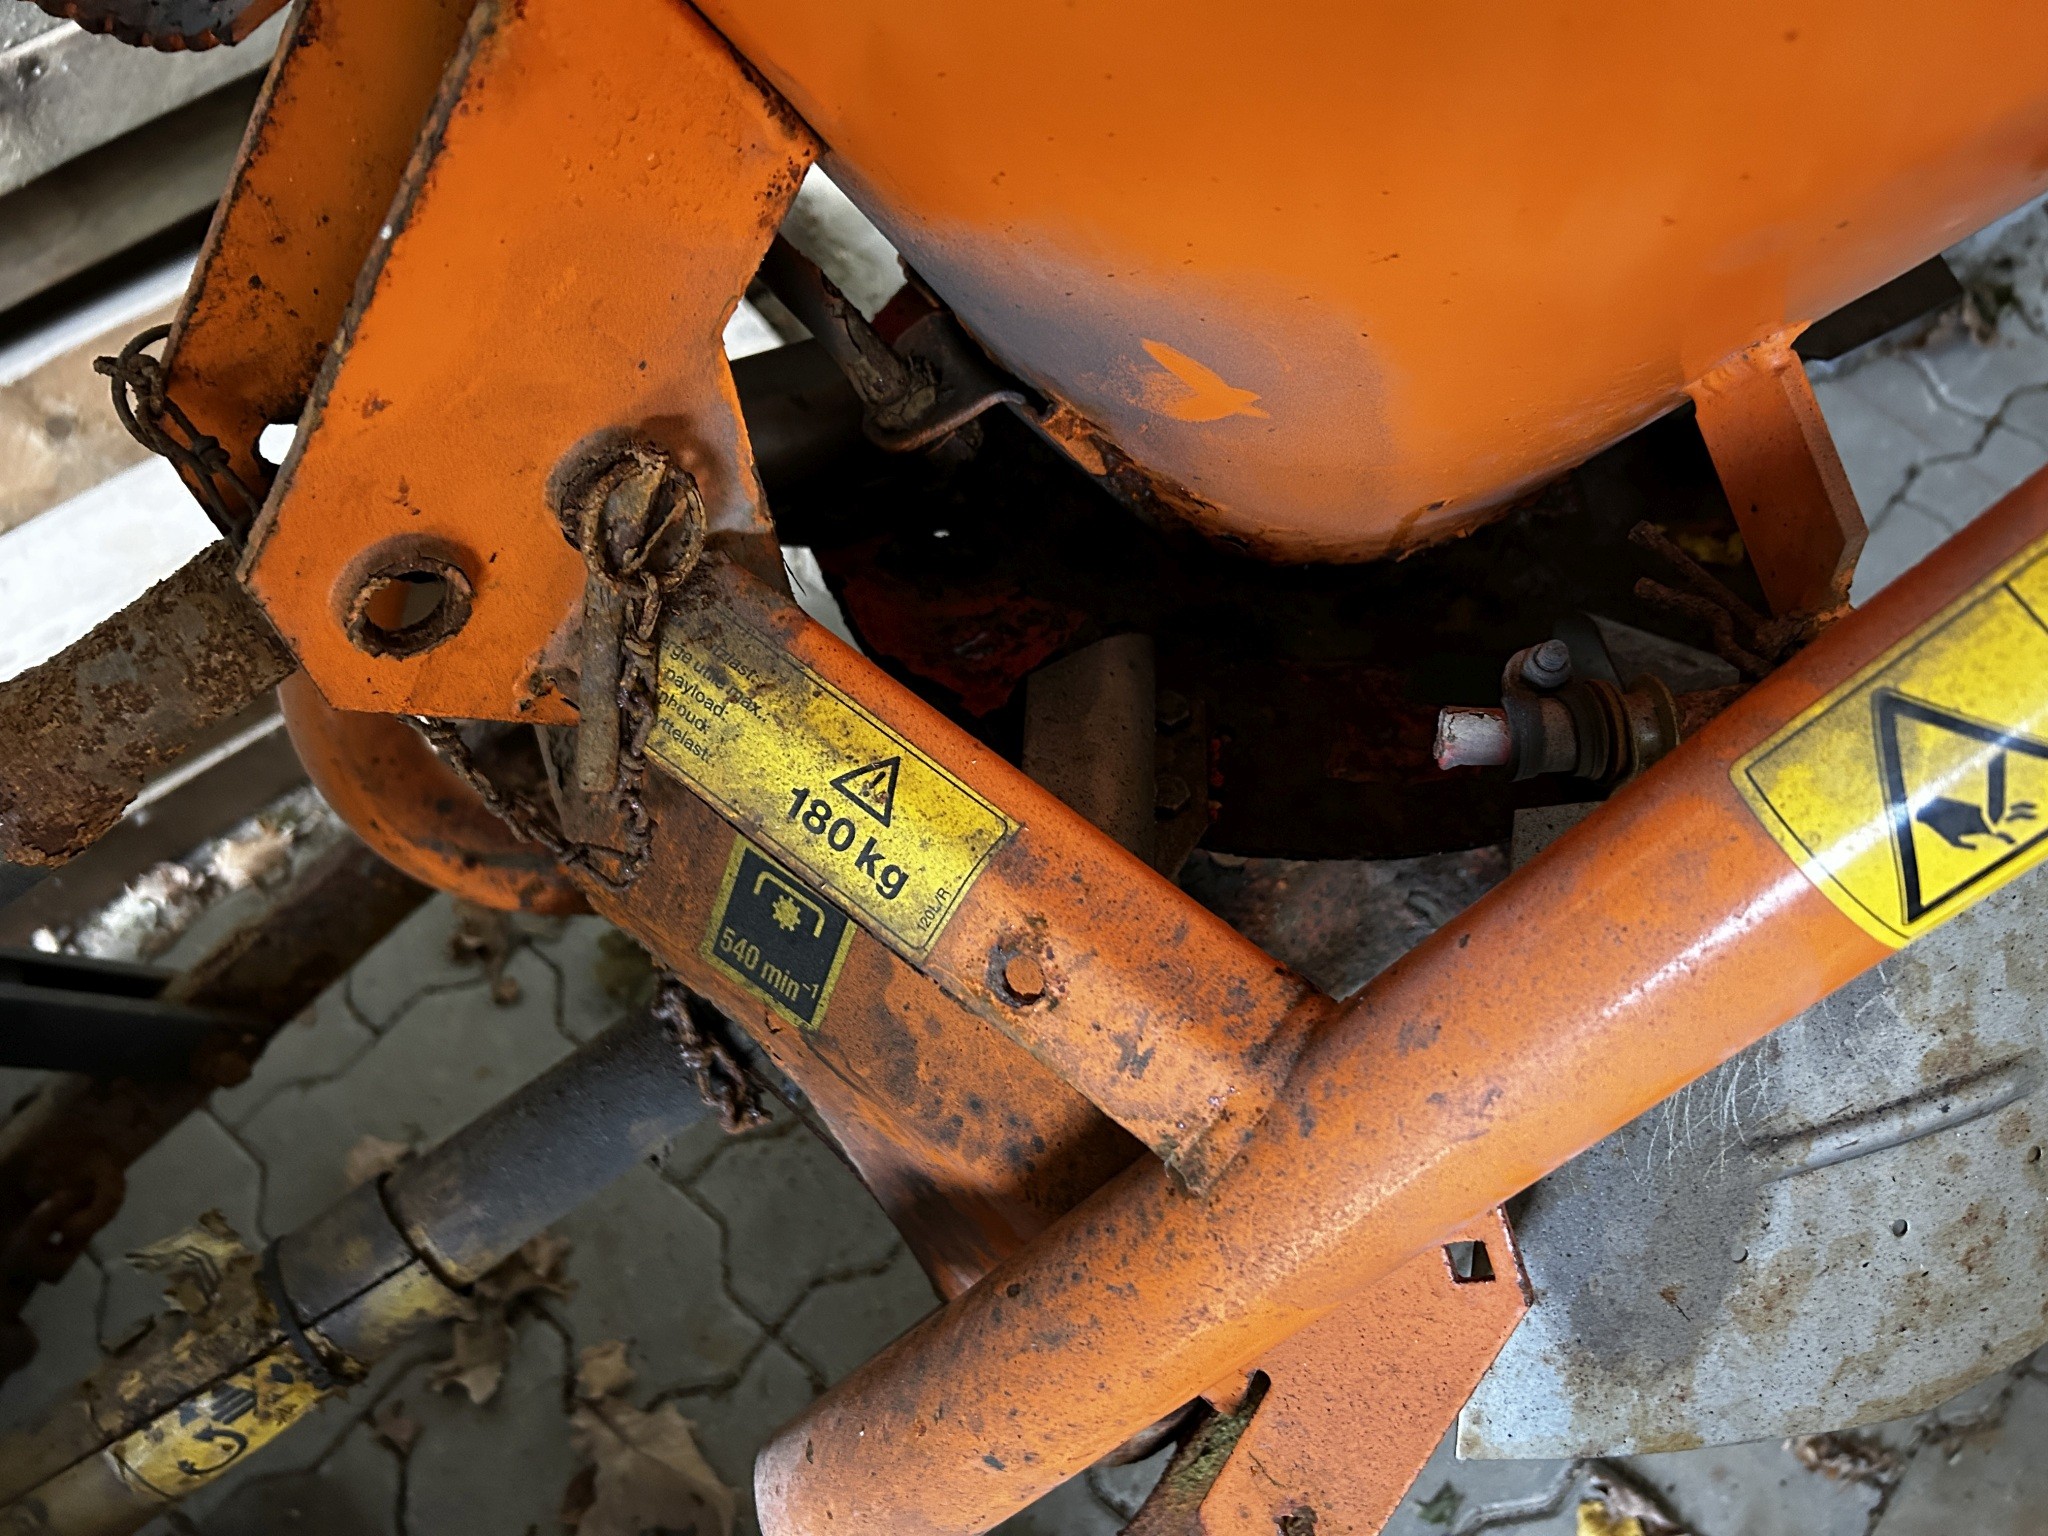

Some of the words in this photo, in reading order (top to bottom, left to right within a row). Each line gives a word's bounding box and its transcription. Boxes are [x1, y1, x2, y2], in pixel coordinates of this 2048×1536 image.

[658, 690, 711, 735] nhoud:
[788, 787, 856, 852] 180
[854, 836, 909, 900] kg
[719, 926, 760, 971] 540
